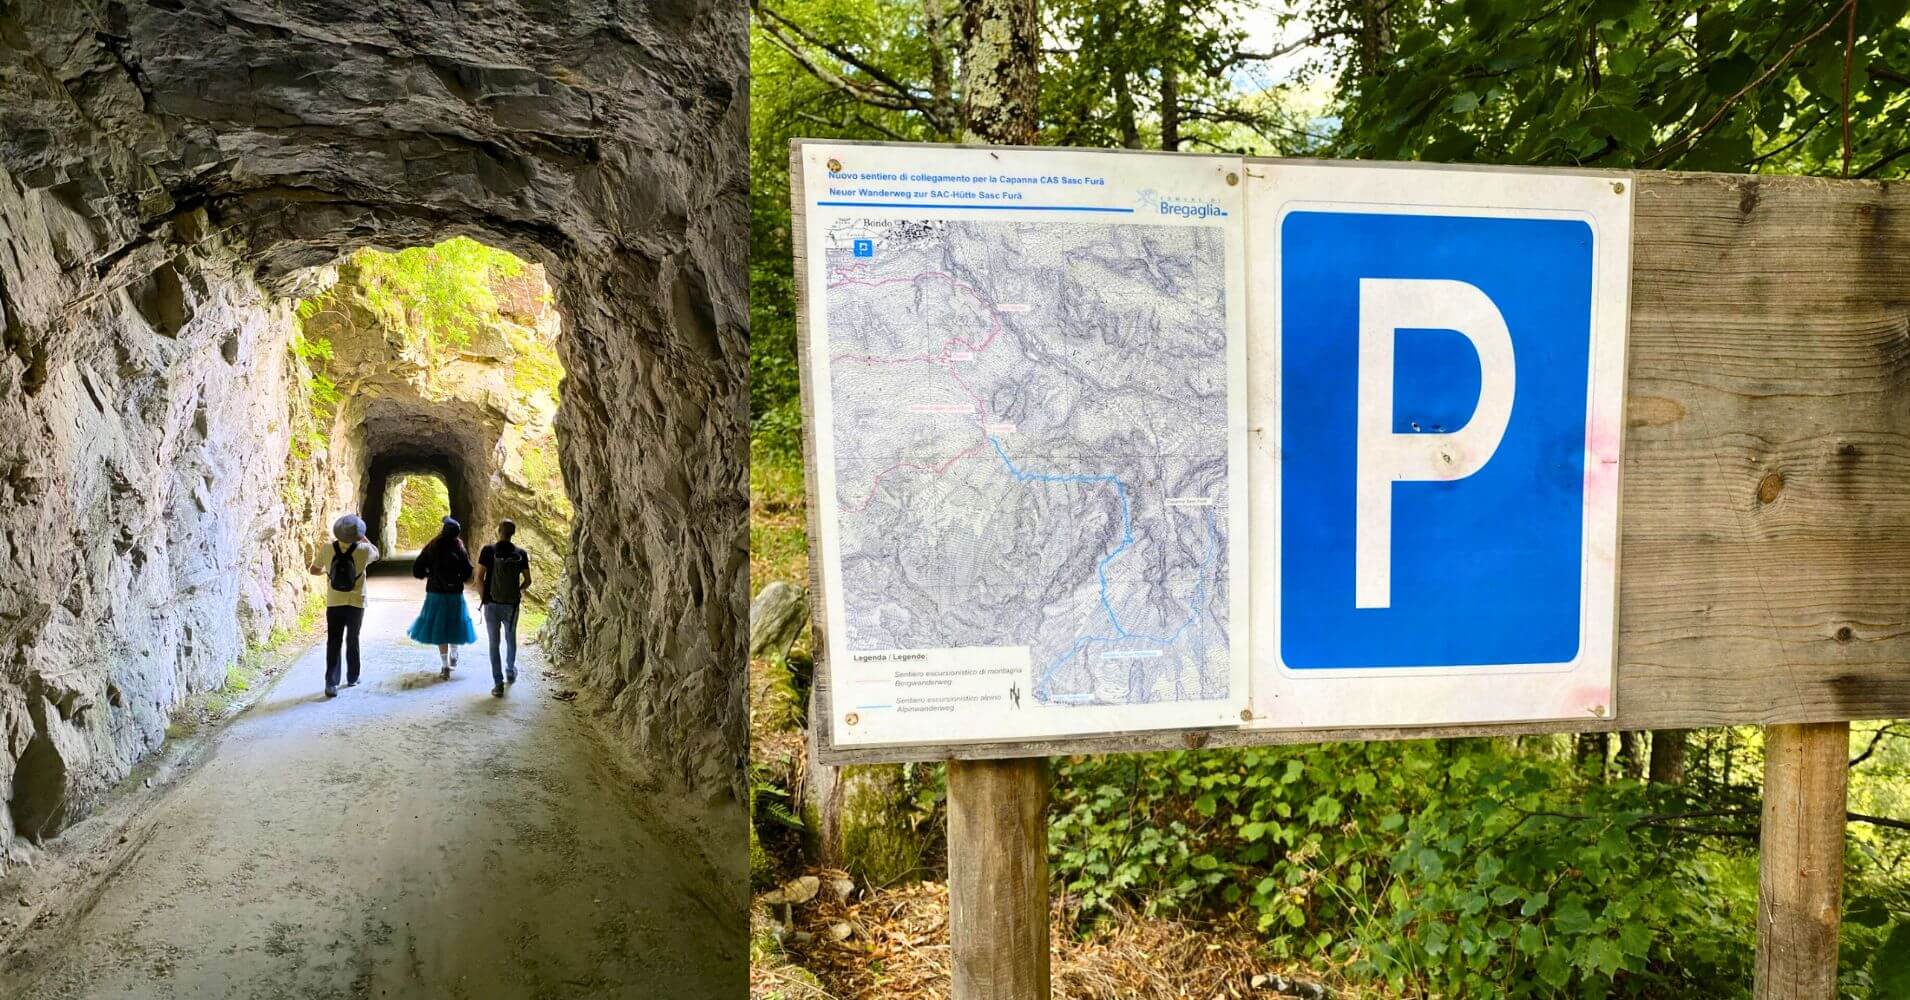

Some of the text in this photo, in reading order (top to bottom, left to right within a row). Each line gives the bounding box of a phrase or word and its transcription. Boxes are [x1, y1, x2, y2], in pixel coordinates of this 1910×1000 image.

[828, 171, 858, 181] Nuovo
[861, 172, 897, 181] sentiero
[900, 172, 908, 181] di
[911, 173, 970, 183] collegamento
[973, 176, 987, 184] per
[1000, 176, 1038, 185] Capanna
[1040, 176, 1059, 185] CAS
[1061, 176, 1082, 185] Sasc
[829, 187, 856, 196] Neuer
[860, 188, 911, 198] Wanderweg
[914, 190, 927, 198] zur
[931, 190, 976, 199] SAC-Hütte
[979, 191, 1000, 199] Sasc
[1160, 201, 1221, 219] Bregaglia
[864, 218, 892, 228] Bondo
[1355, 277, 1516, 609] P
[853, 654, 887, 662] Legenda
[894, 680, 952, 688] Bergwanderweg
